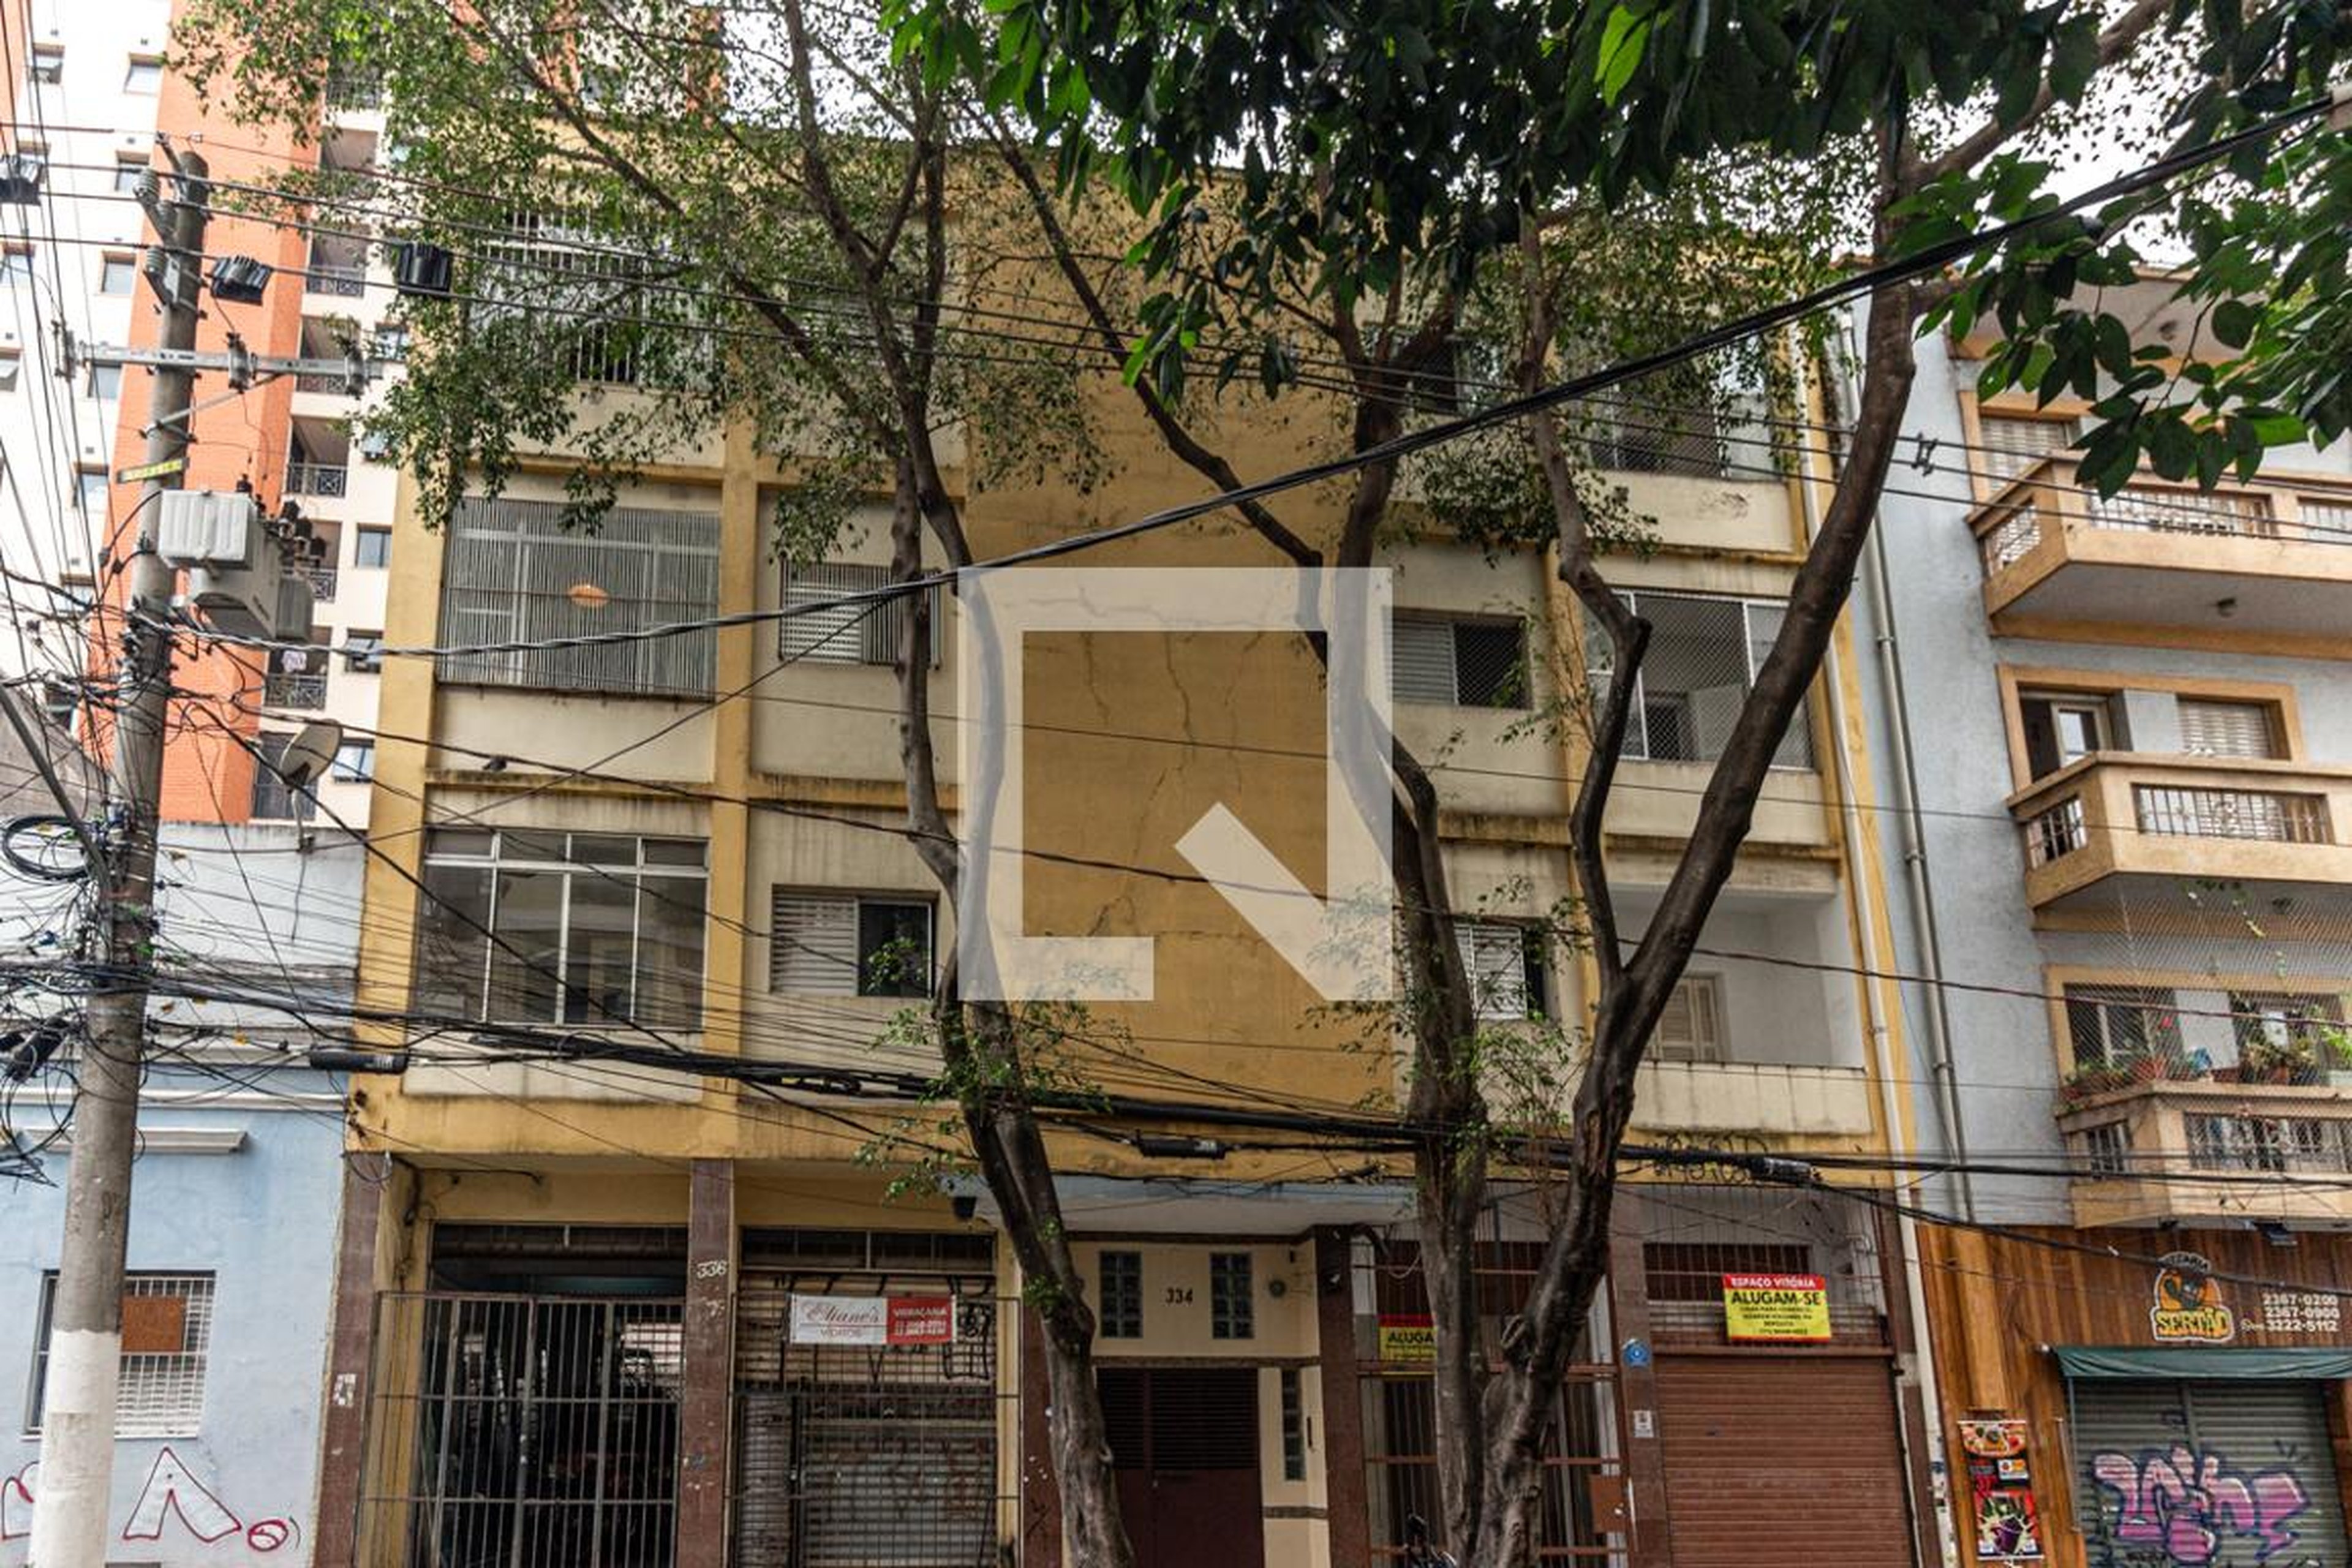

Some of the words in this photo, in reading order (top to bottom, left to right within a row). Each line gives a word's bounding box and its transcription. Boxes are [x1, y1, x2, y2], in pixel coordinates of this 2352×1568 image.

[1731, 1276, 1771, 1287] ESPAÇO
[1773, 1275, 1817, 1288] VITÓRIA
[1165, 1286, 1193, 1303] 334
[1732, 1291, 1822, 1305] ALUGAM-SE
[2155, 1307, 2232, 1336] SERTÃO
